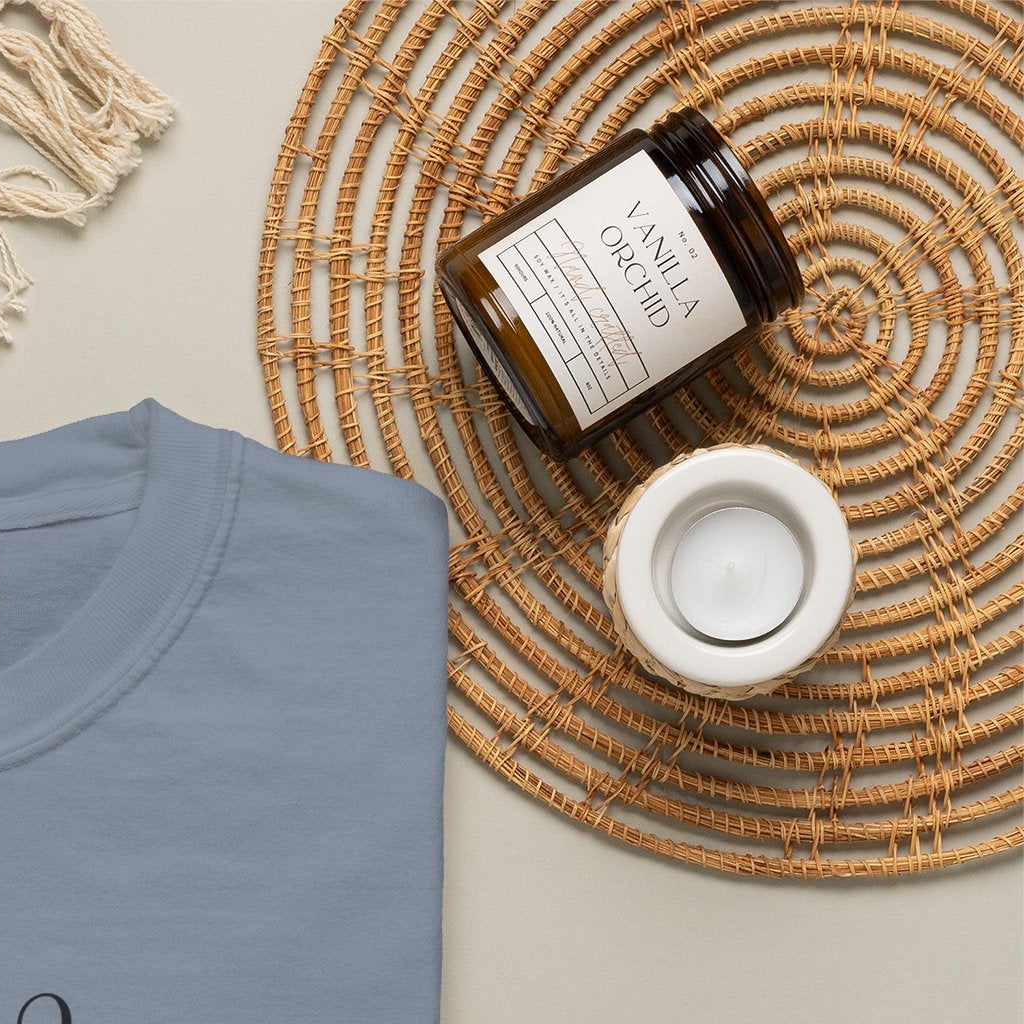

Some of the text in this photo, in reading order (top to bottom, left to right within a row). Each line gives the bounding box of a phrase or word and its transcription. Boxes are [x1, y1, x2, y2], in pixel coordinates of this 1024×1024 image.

[534, 254, 544, 267] SOY
[544, 269, 555, 283] WAX
[569, 309, 579, 322] ALL
[585, 335, 596, 349] THE
[593, 351, 611, 380] DETAILS
[600, 225, 670, 327] ORCHID
[627, 200, 700, 318] VANILLA
